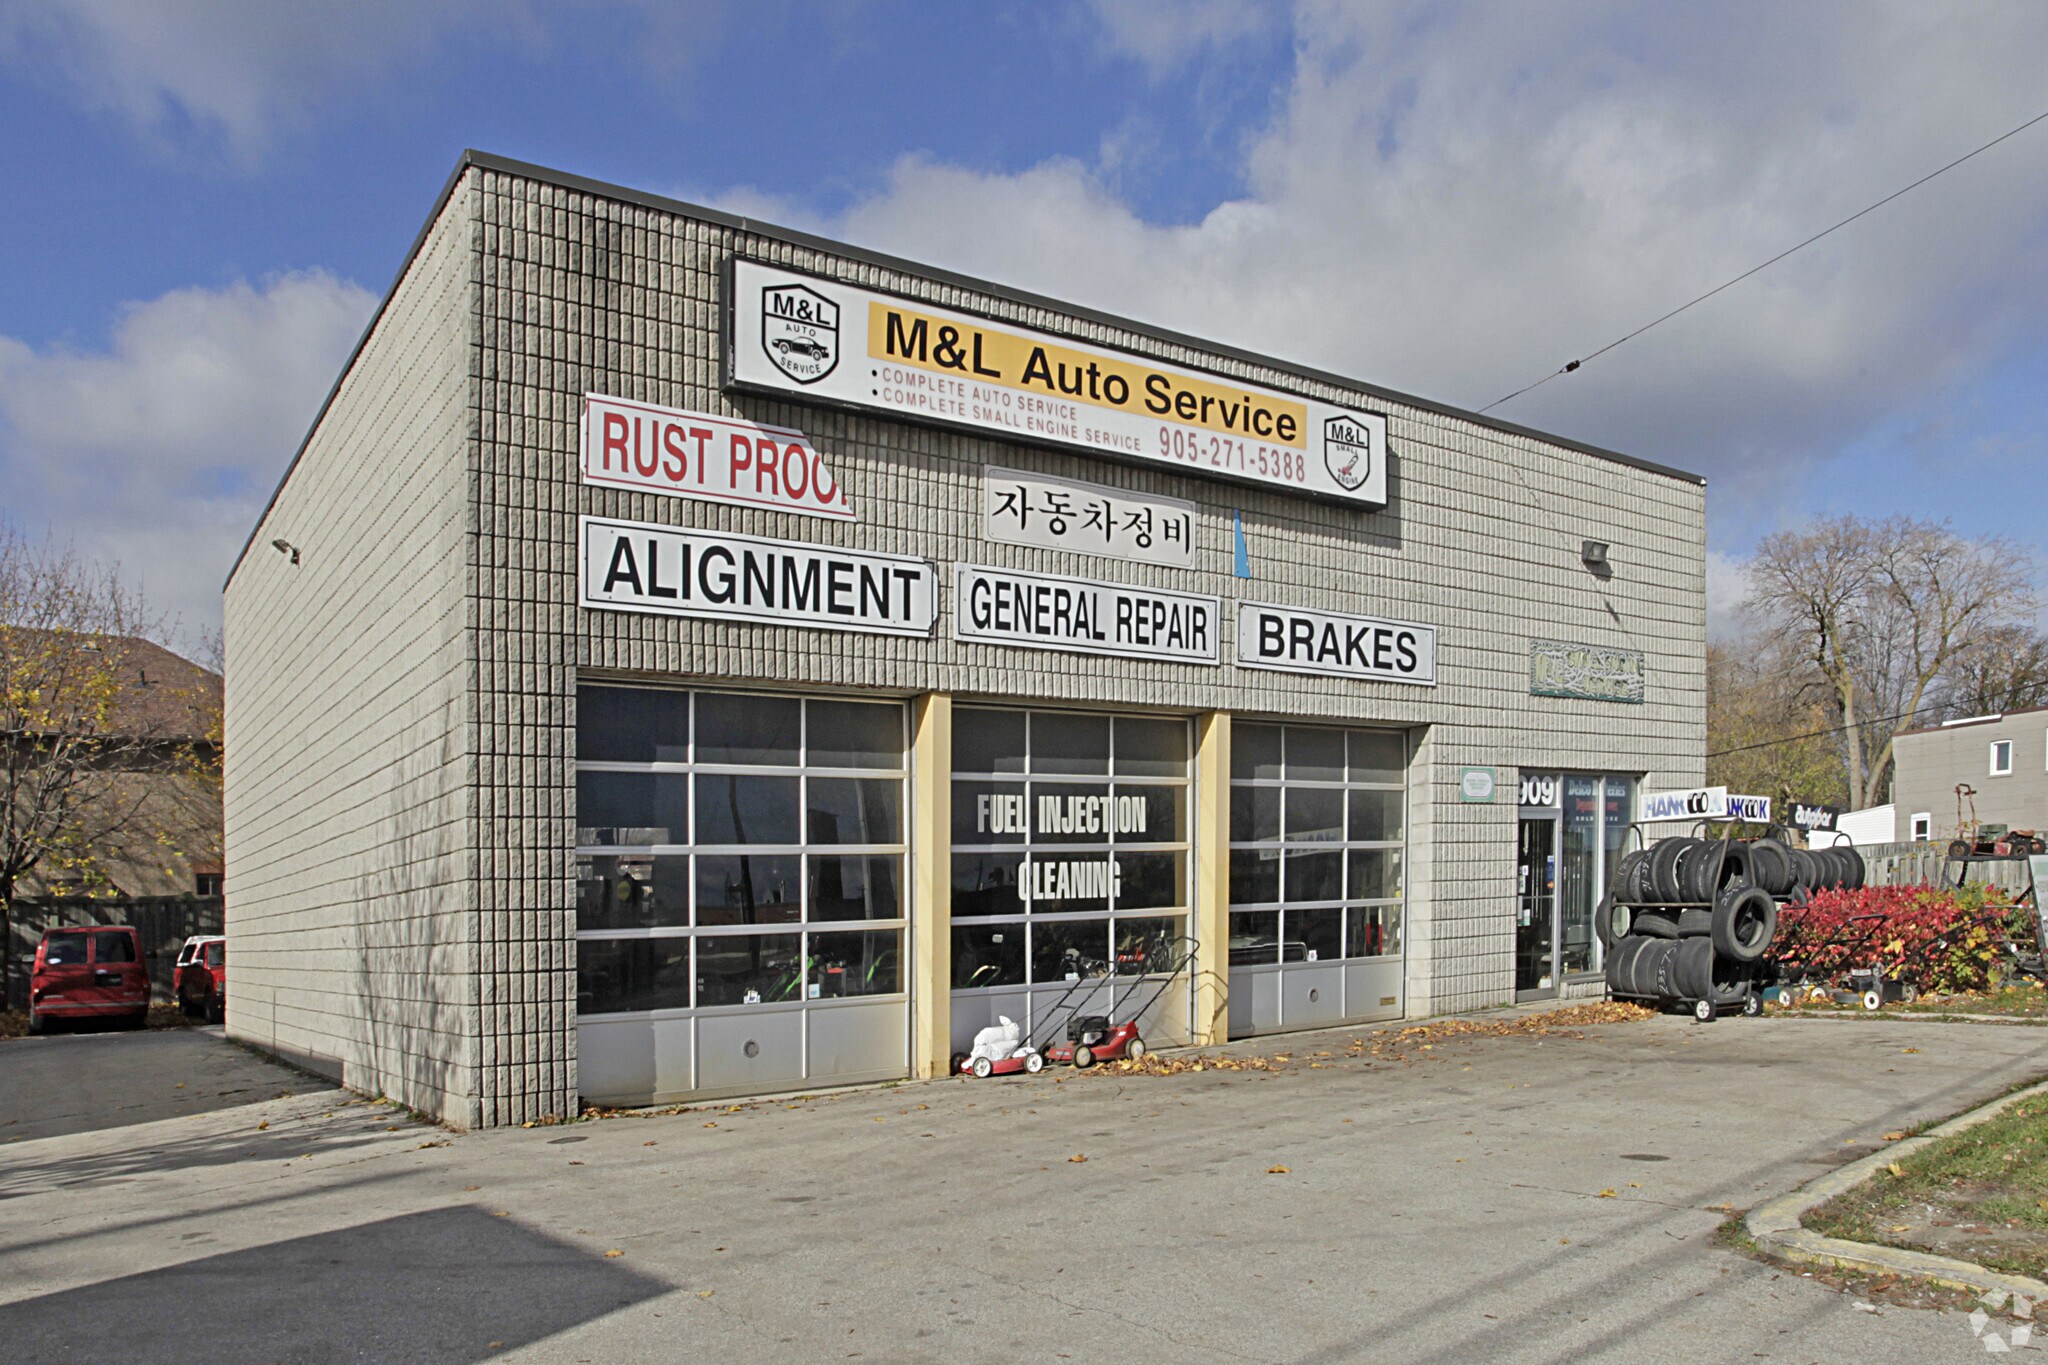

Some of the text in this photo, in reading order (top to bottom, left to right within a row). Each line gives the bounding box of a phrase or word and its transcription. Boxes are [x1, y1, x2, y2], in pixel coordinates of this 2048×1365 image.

[774, 292, 830, 325] M&L
[785, 323, 816, 337] AUTO
[780, 356, 821, 374] SERVICE
[886, 311, 1297, 441] M&L Auto Service
[882, 367, 1077, 421] COMPLETE AUTO SERVICE
[882, 387, 1141, 451] COMPLETE SMALL ENGINE SERVICE
[603, 411, 847, 506] RUST PROO
[1159, 426, 1305, 483] 905-271-5388
[1331, 423, 1365, 446] M&L
[991, 484, 1190, 555] 자동차정비
[603, 535, 921, 621] ALIGNMENT
[970, 577, 1208, 651] GENERAL REPAIR
[1259, 613, 1417, 673] BRAKES
[977, 794, 1147, 834] FUEL INJECTION
[1018, 861, 1121, 900] CLEANING
